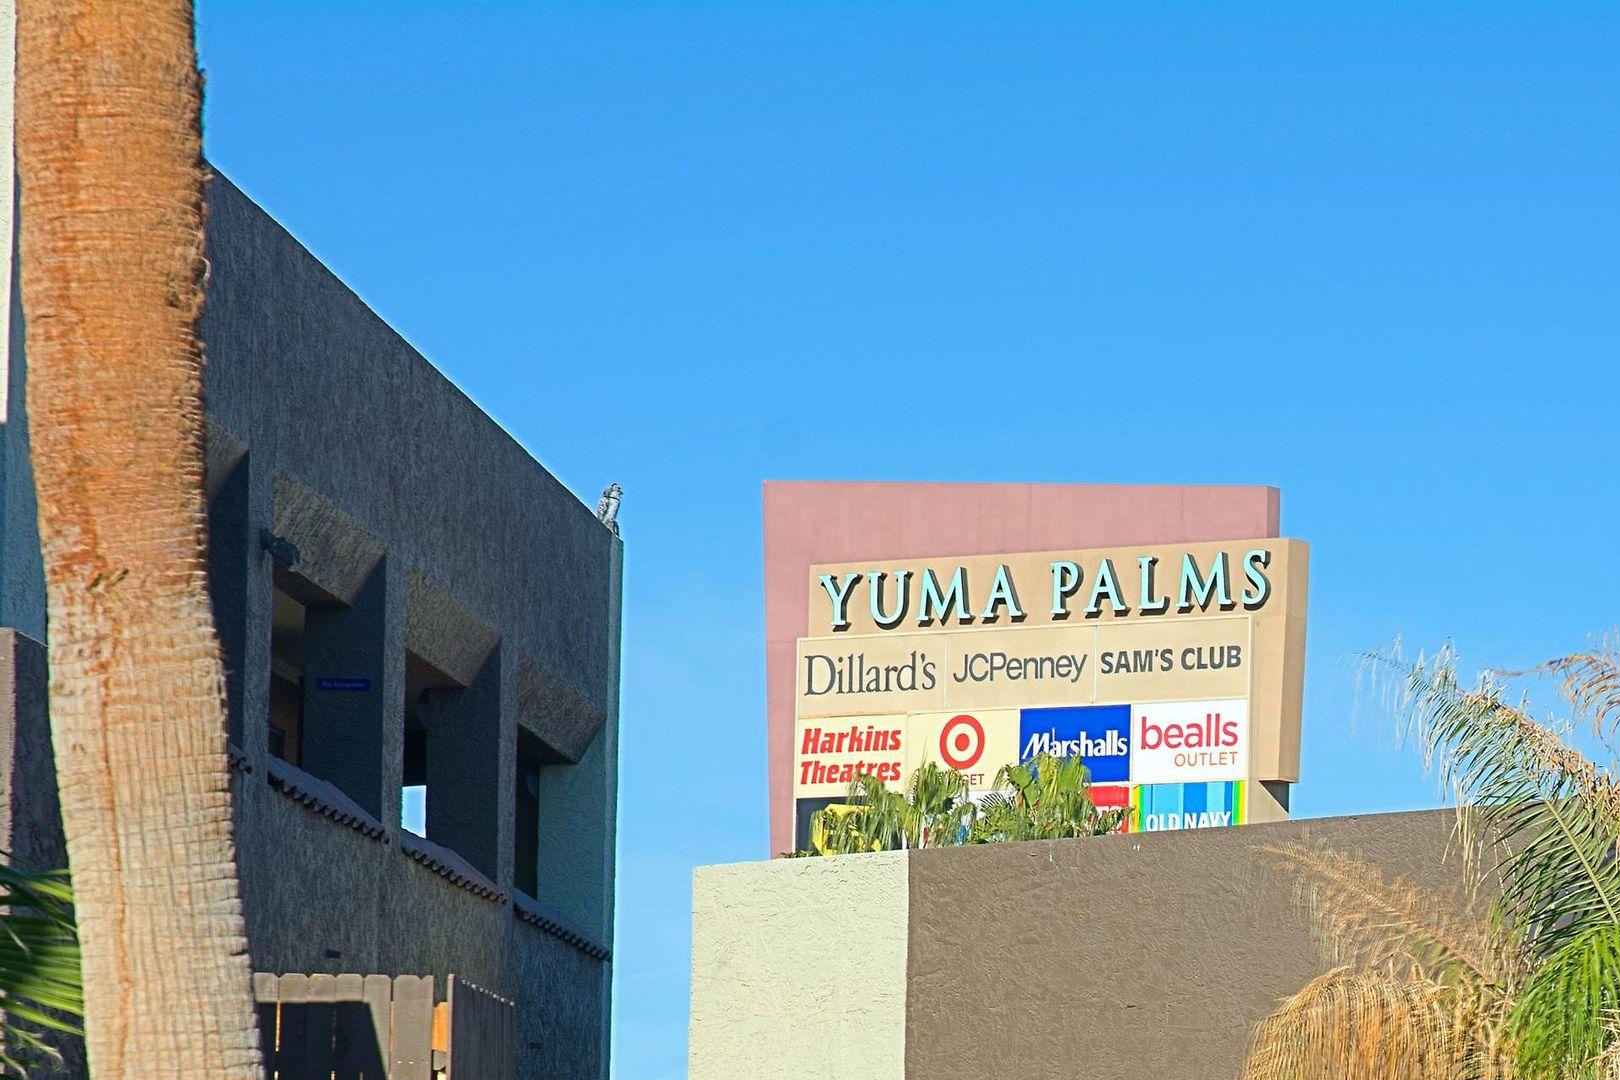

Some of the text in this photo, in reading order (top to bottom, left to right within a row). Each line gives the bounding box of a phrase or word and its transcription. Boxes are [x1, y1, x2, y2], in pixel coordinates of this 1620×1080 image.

[818, 549, 1270, 629] YUMA PALMS
[804, 650, 936, 696] Dillard's
[953, 652, 1088, 683] JCPenney
[1100, 645, 1242, 675] SAM'S CLUB
[801, 726, 902, 755] Harkins
[1022, 727, 1128, 759] Marshalls
[1141, 713, 1239, 750] bealls
[800, 760, 902, 785] Theatres
[1174, 751, 1239, 767] OUTLET
[1145, 813, 1181, 832] OLD
[1184, 811, 1232, 830] NAVY
